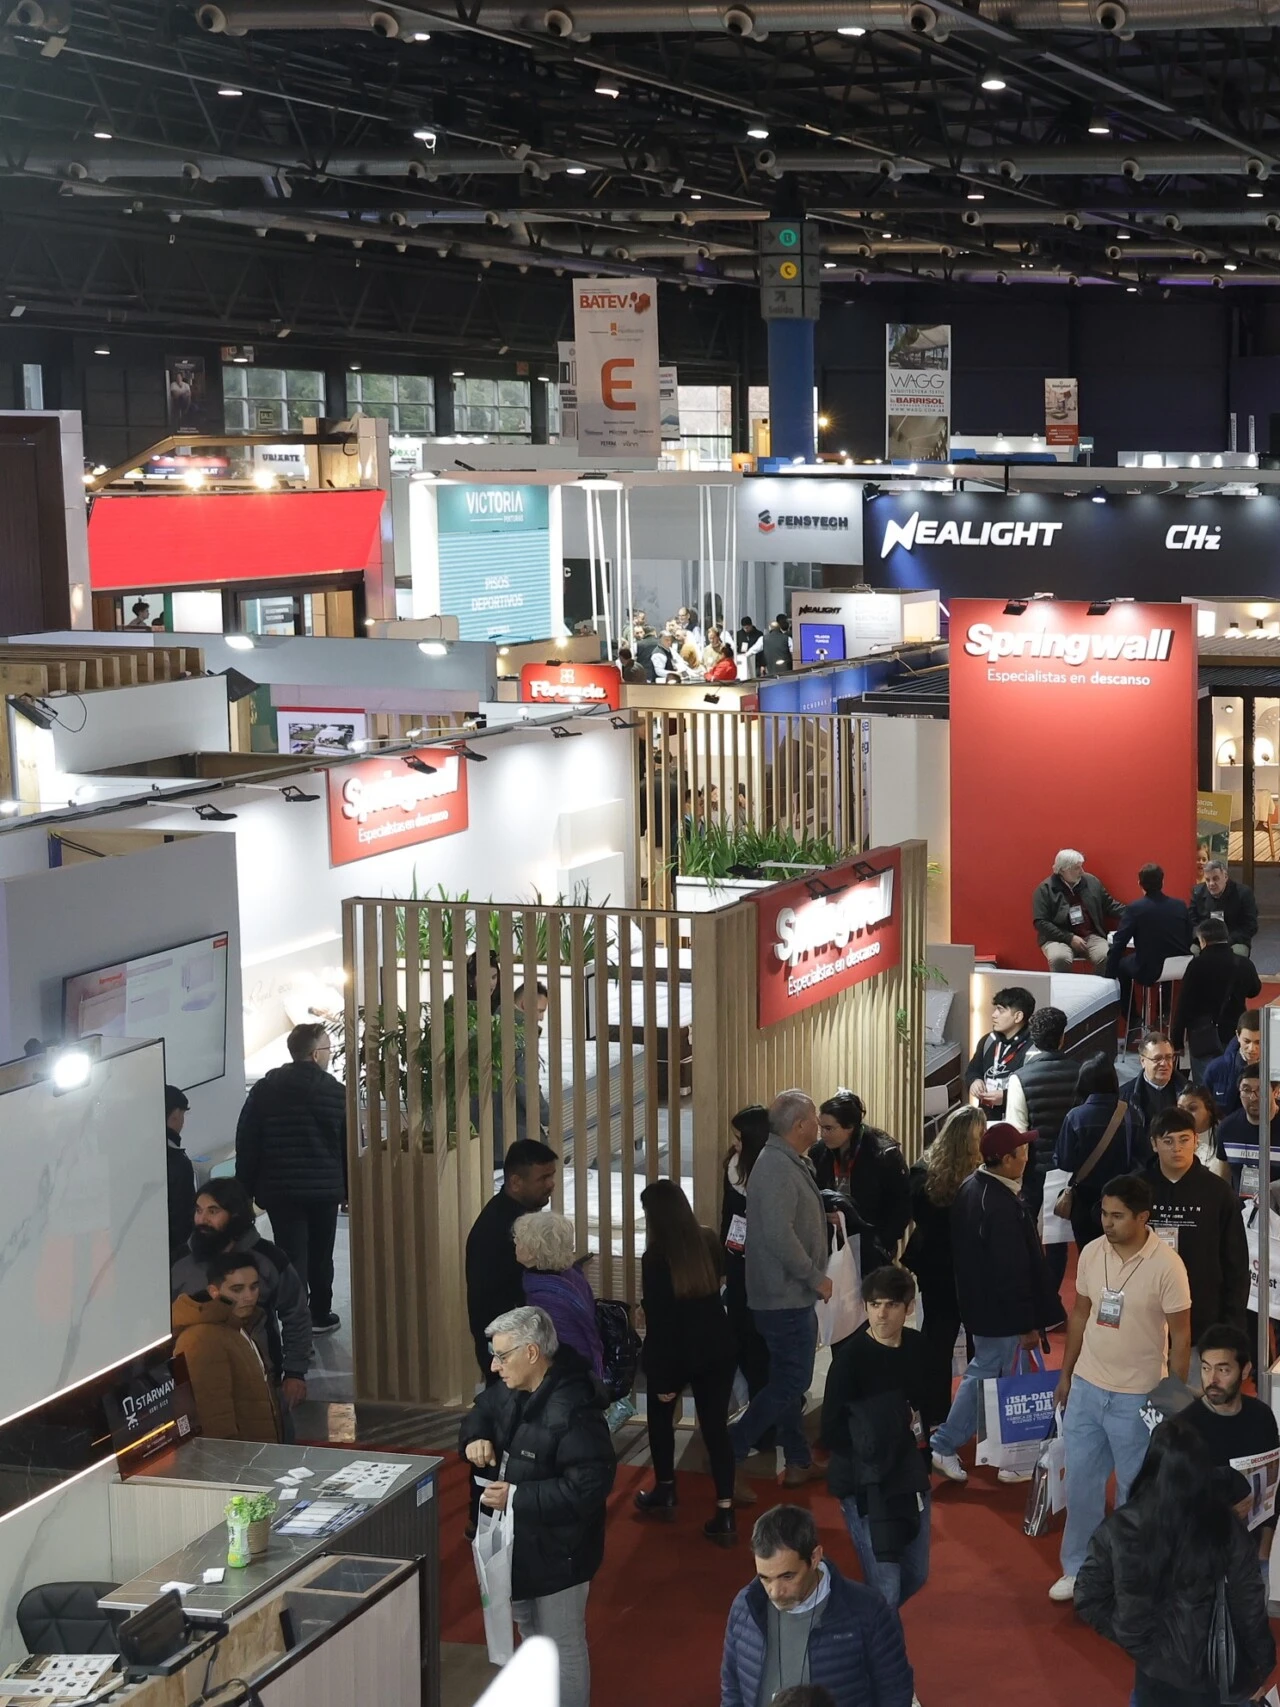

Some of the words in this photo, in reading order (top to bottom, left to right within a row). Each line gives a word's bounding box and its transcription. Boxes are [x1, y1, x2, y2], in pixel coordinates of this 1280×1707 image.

[601, 358, 636, 411] E
[890, 373, 945, 389] WAGG
[466, 490, 524, 514] VICTORIA
[777, 514, 849, 529] FENSTECH
[472, 594, 524, 611] DEPORTIVOS
[964, 622, 1174, 666] Springwall
[987, 668, 1067, 684] Especialistas
[1070, 673, 1086, 684] en
[1090, 671, 1151, 686] descanso
[788, 965, 836, 998] Especialistas
[835, 959, 845, 973] en
[845, 942, 881, 968] descanso
[1152, 1204, 1201, 1212] ROOKLYN
[135, 1378, 176, 1411] STARWAY
[1005, 1399, 1054, 1417] BUL-DA
